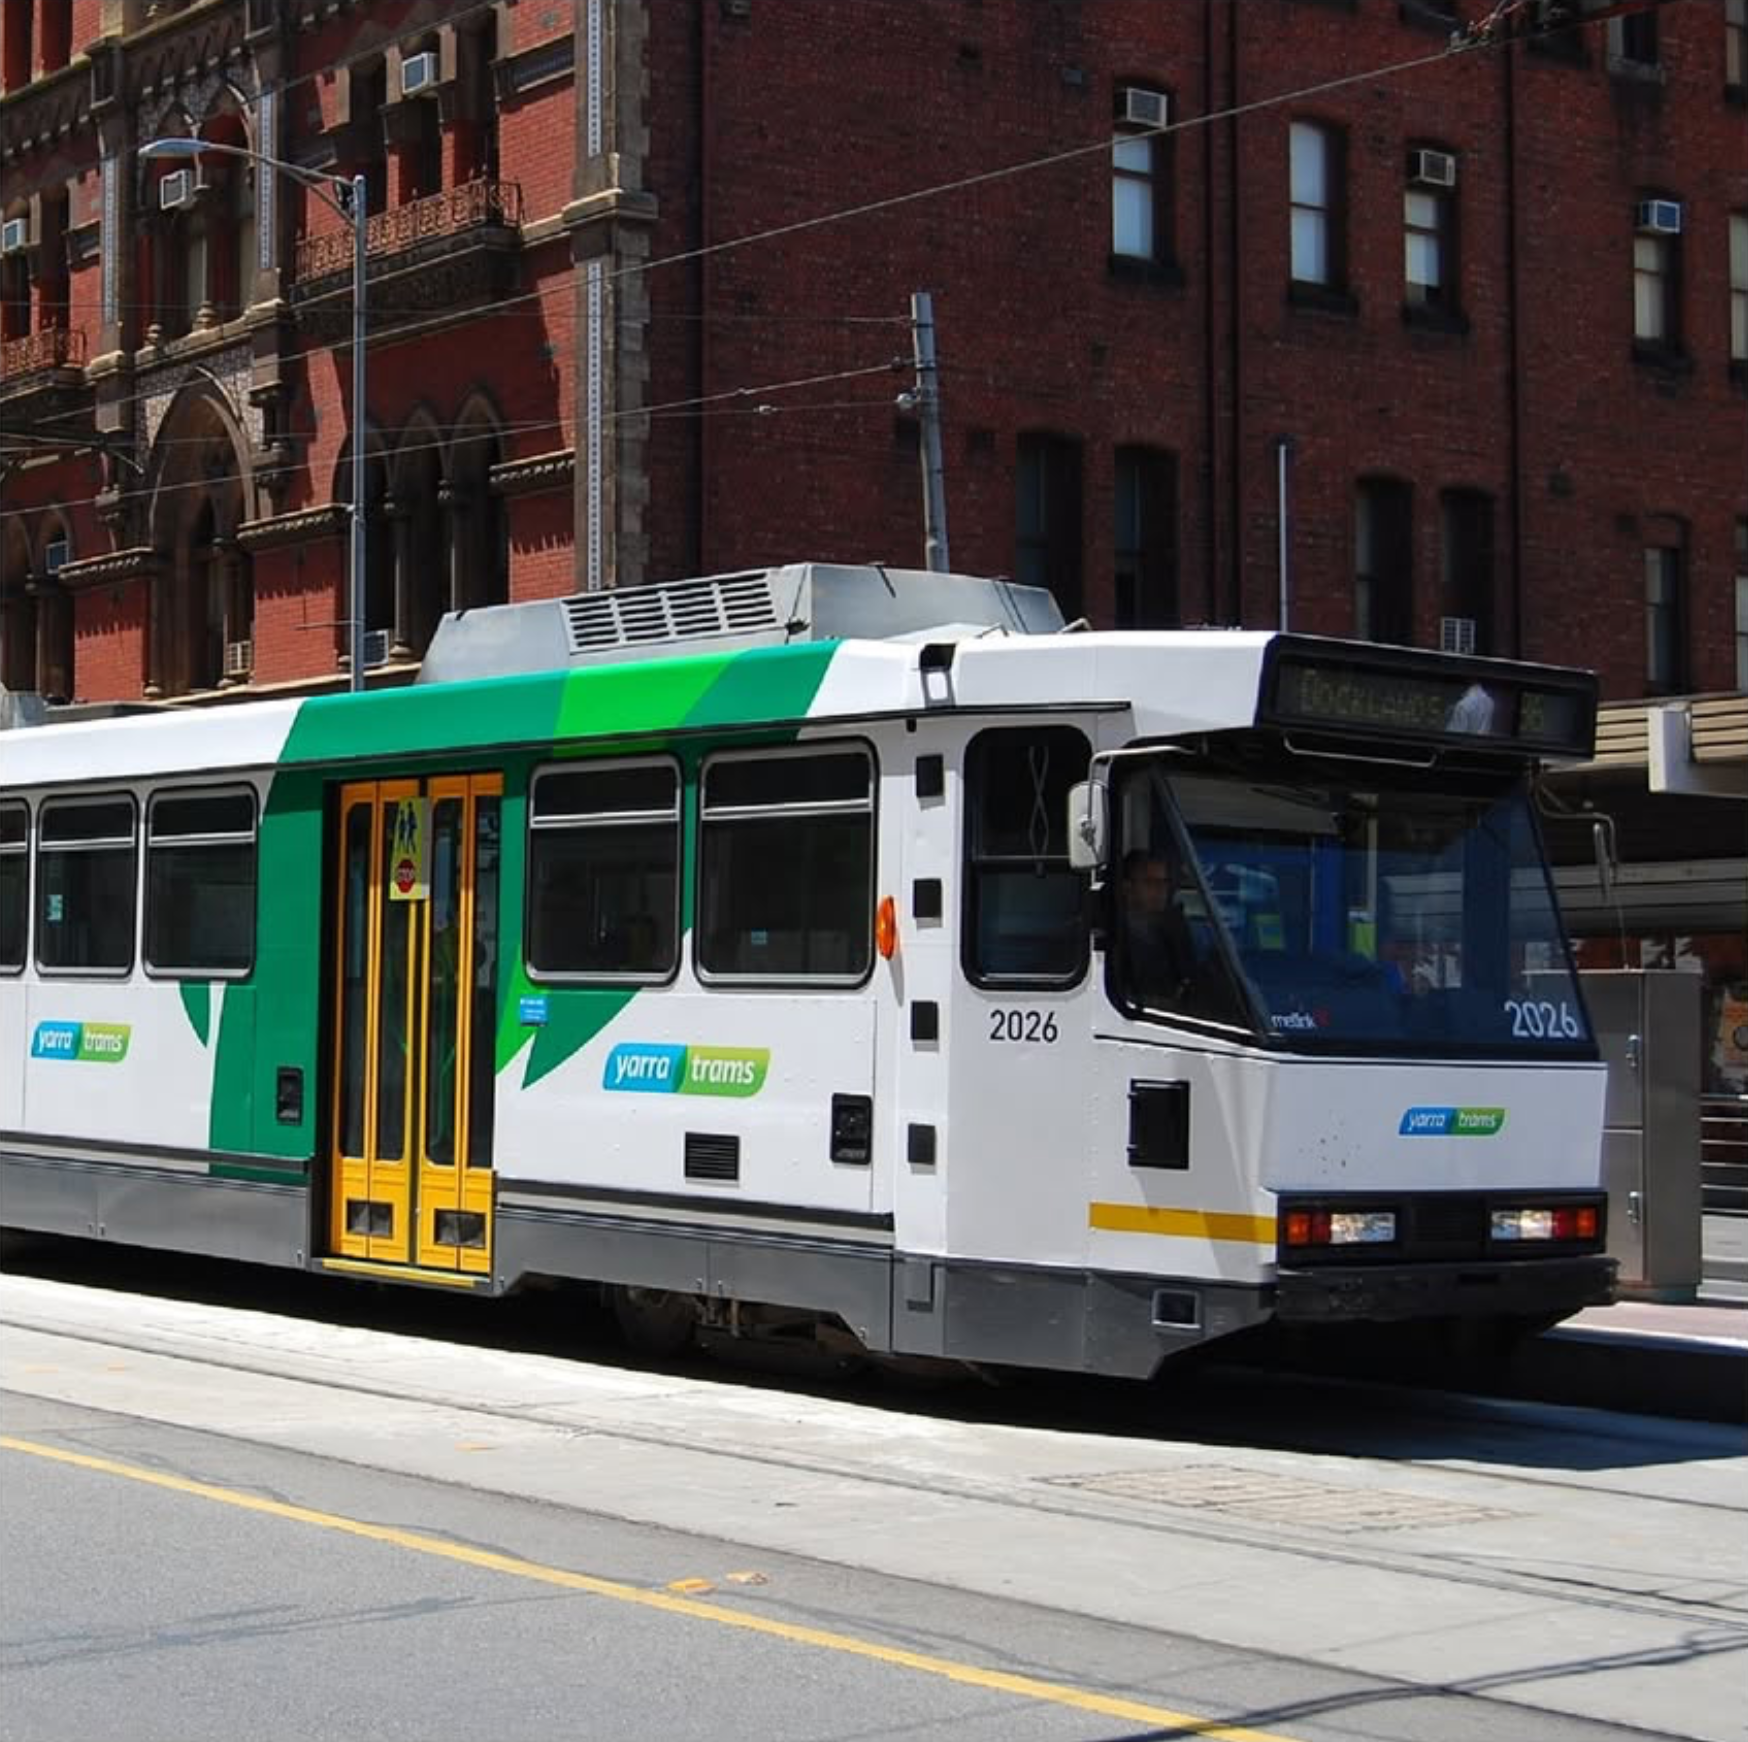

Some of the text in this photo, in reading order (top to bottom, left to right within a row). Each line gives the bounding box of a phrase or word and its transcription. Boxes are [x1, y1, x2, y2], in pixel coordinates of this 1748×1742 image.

[989, 1009, 1058, 1043] 2026
[1504, 1000, 1578, 1038] 2026
[38, 1029, 123, 1054] yarra trams
[615, 1054, 755, 1084] yarra trams
[1407, 1111, 1496, 1132] yarra trams
